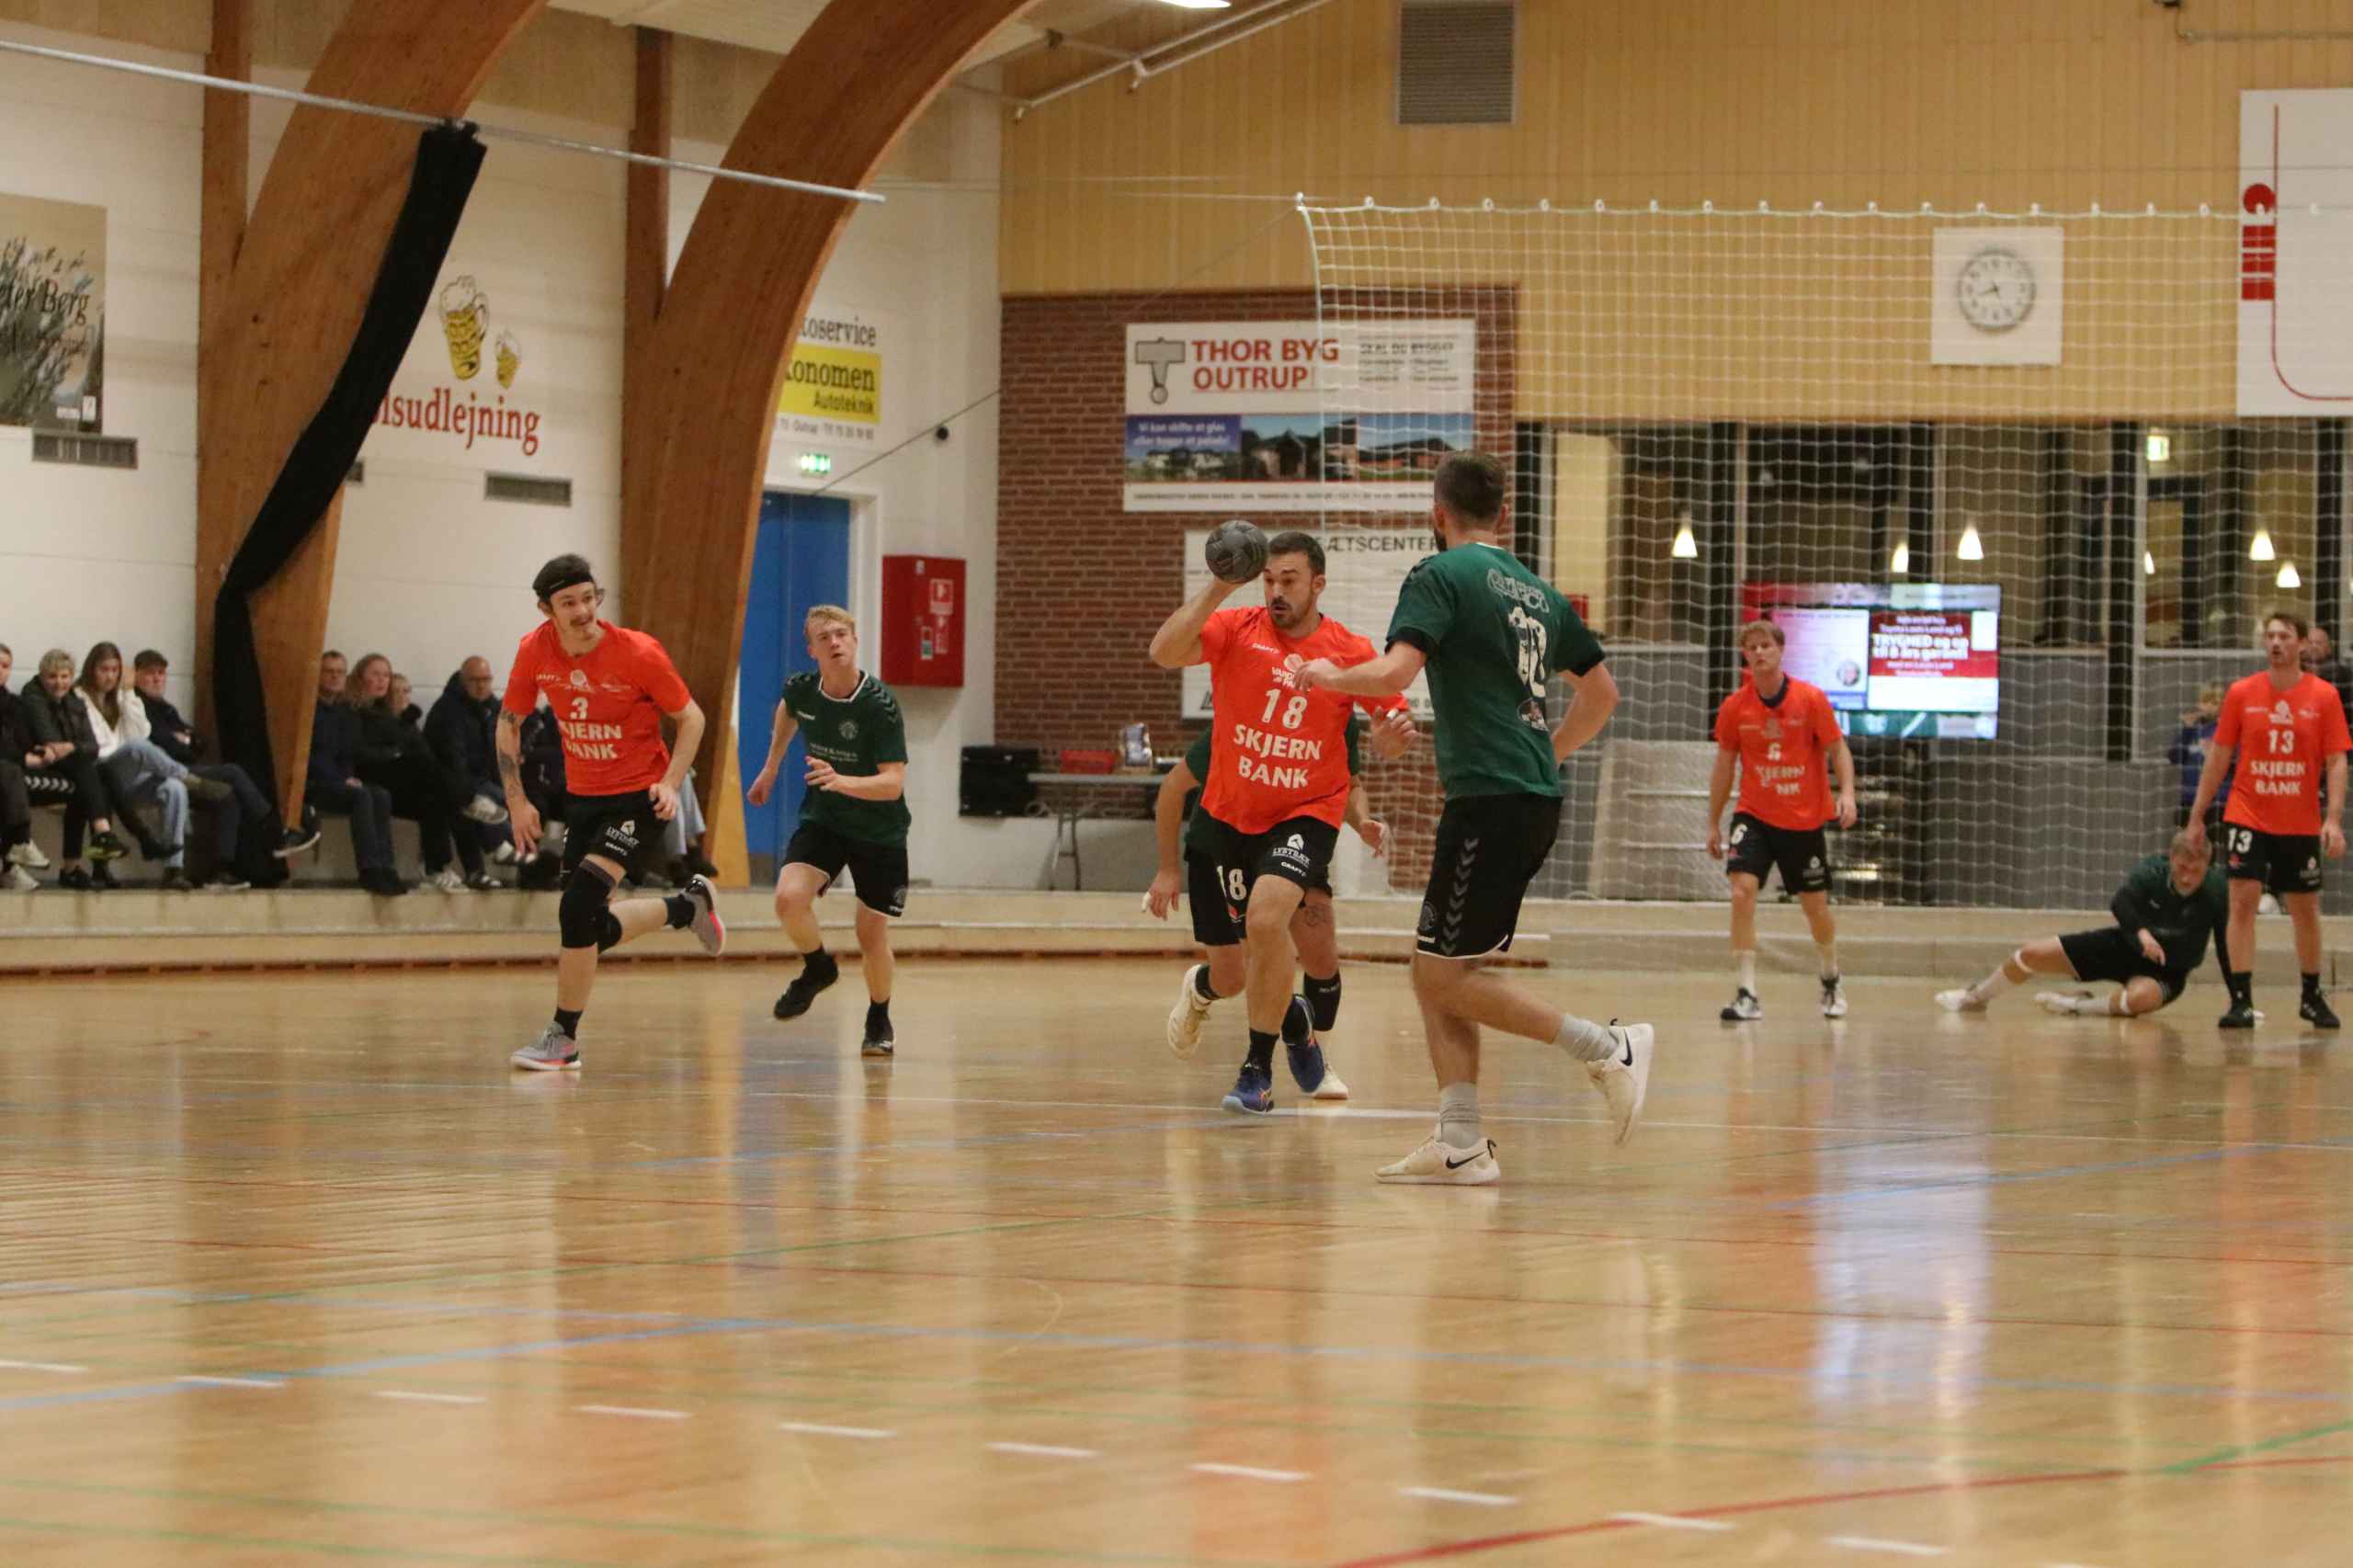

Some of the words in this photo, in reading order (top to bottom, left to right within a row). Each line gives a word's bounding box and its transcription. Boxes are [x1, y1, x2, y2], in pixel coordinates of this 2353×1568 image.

[41, 278, 90, 324] Berg
[1191, 339, 1271, 361] THOR
[1282, 339, 1339, 361] BYG
[1193, 366, 1309, 390] OUTRUP
[371, 387, 540, 456] lsudlejning
[570, 697, 589, 721] 3
[1261, 687, 1308, 729] 18
[564, 738, 619, 761] ANK
[1233, 723, 1323, 761] SKJERN
[2268, 730, 2295, 755] 13
[1238, 756, 1309, 789] BANK
[2250, 760, 2305, 778] SKJERN
[2255, 779, 2302, 796] BANK
[1731, 824, 1748, 846] 6
[2228, 828, 2253, 853] 13
[1217, 865, 1247, 901] 18
